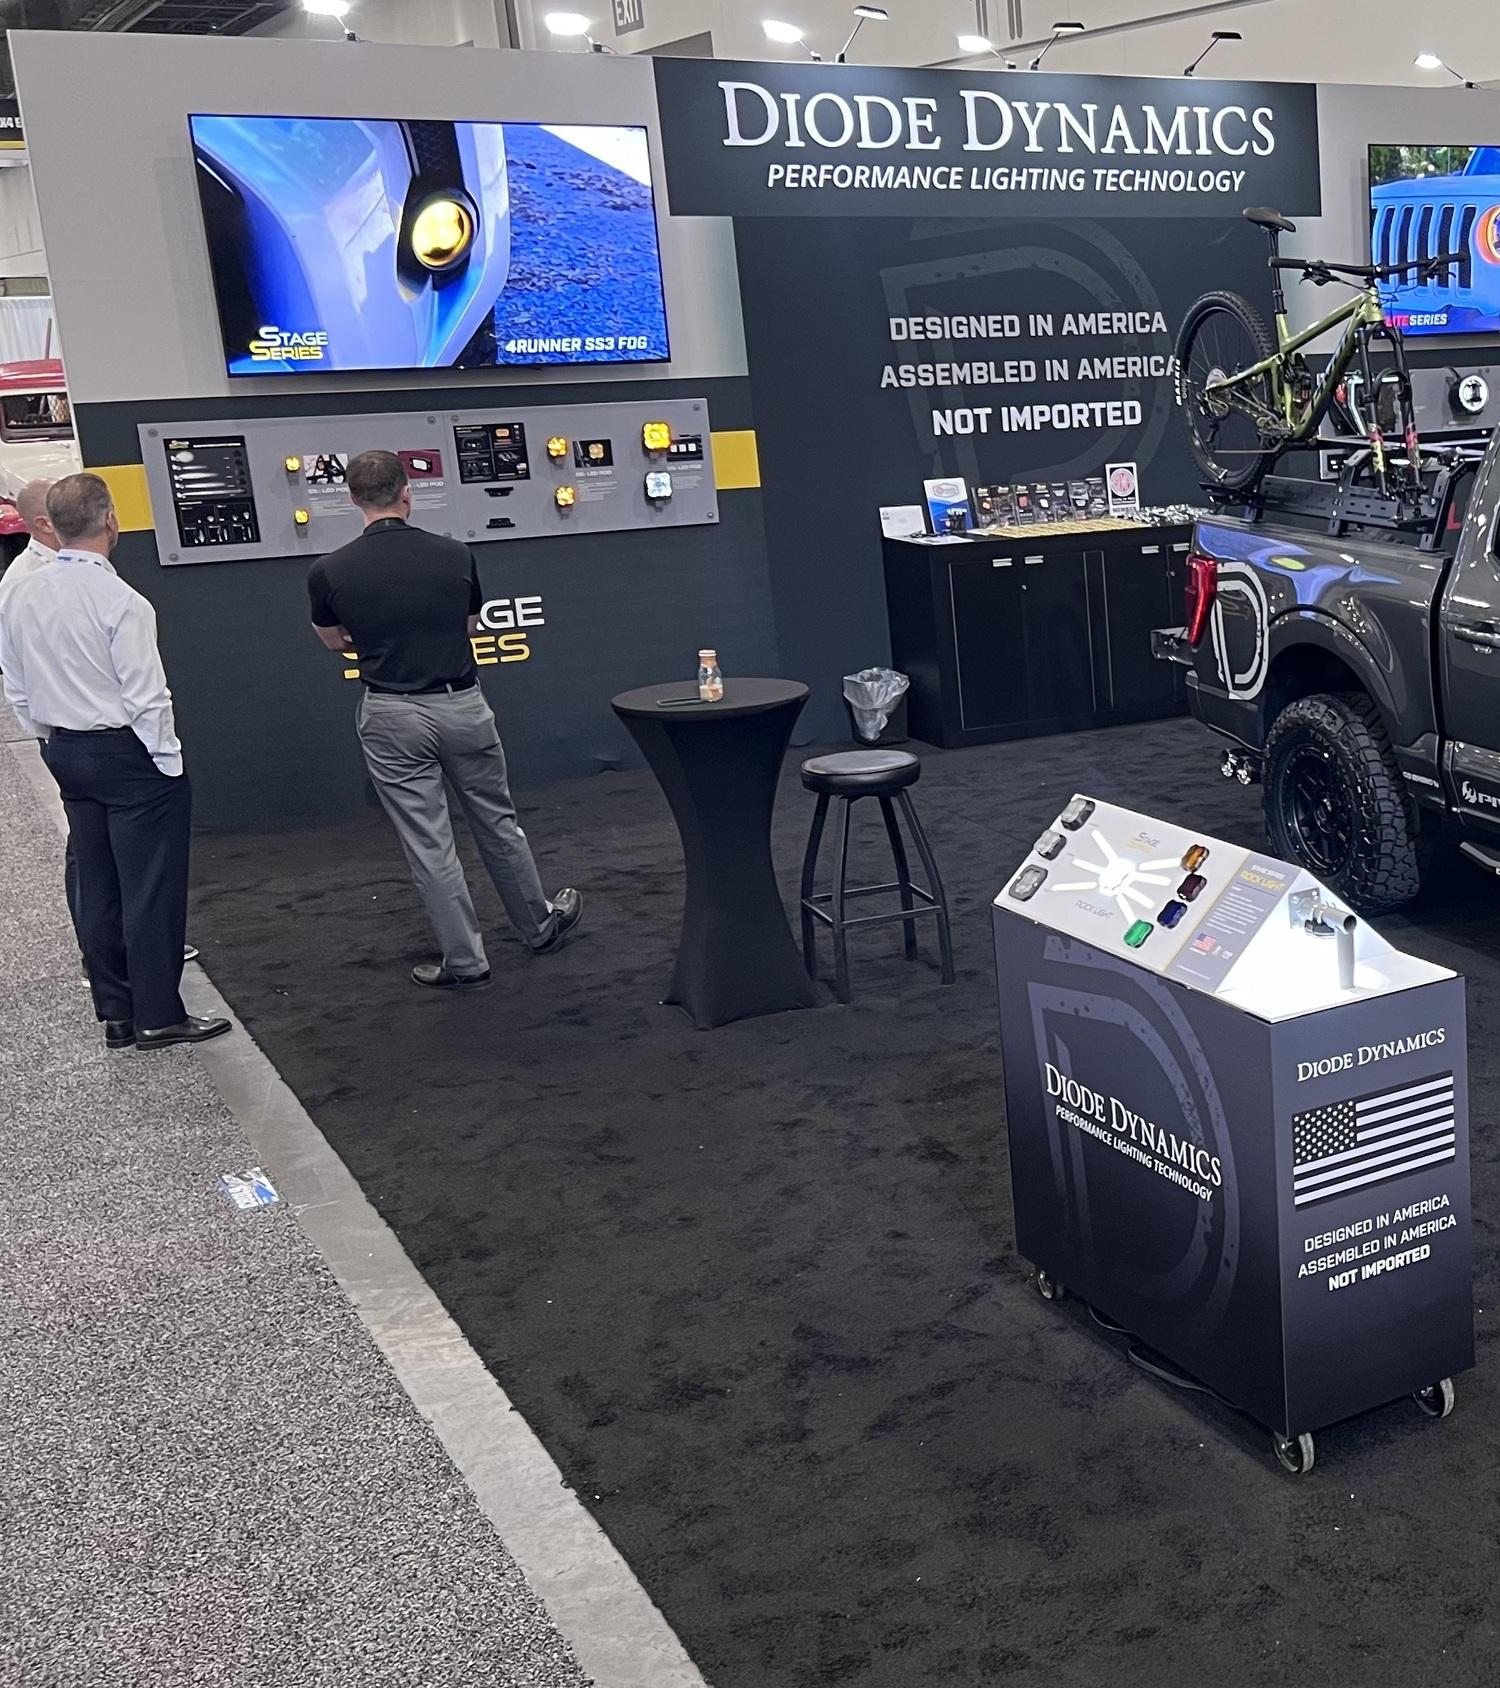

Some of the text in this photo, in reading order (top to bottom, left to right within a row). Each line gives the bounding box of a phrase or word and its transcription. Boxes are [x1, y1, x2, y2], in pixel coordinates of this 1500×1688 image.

[614, 0, 639, 26] EXIT
[717, 80, 1276, 157] DIODE DYNAMICS
[767, 164, 1246, 193] PERFORMANCE LIGHTING TECHNOLOGY
[259, 326, 329, 346] STAGE
[889, 311, 1168, 341] DESIGNED IN AMERICA
[1409, 313, 1448, 326] SERIES
[249, 341, 324, 361] SERIES
[504, 336, 648, 354] 4RUNNER SS3 FOG
[880, 359, 1036, 389] ASSEMBLED
[1045, 358, 1070, 382] IN
[932, 400, 1143, 436] NOT IMPORTED
[1297, 1027, 1445, 1082] DIODE DYNAMICS
[1044, 1062, 1222, 1186] DIODE DYNAMICS
[1055, 1105, 1213, 1202] PERFORMANCE LIGHTING TECHNOLOGY
[1303, 1194, 1451, 1254] DESIGNED IN AMERICA
[1297, 1214, 1457, 1278] ASSEMBLED IN AMERICA
[1328, 1243, 1432, 1292] NOT IMPORTED
